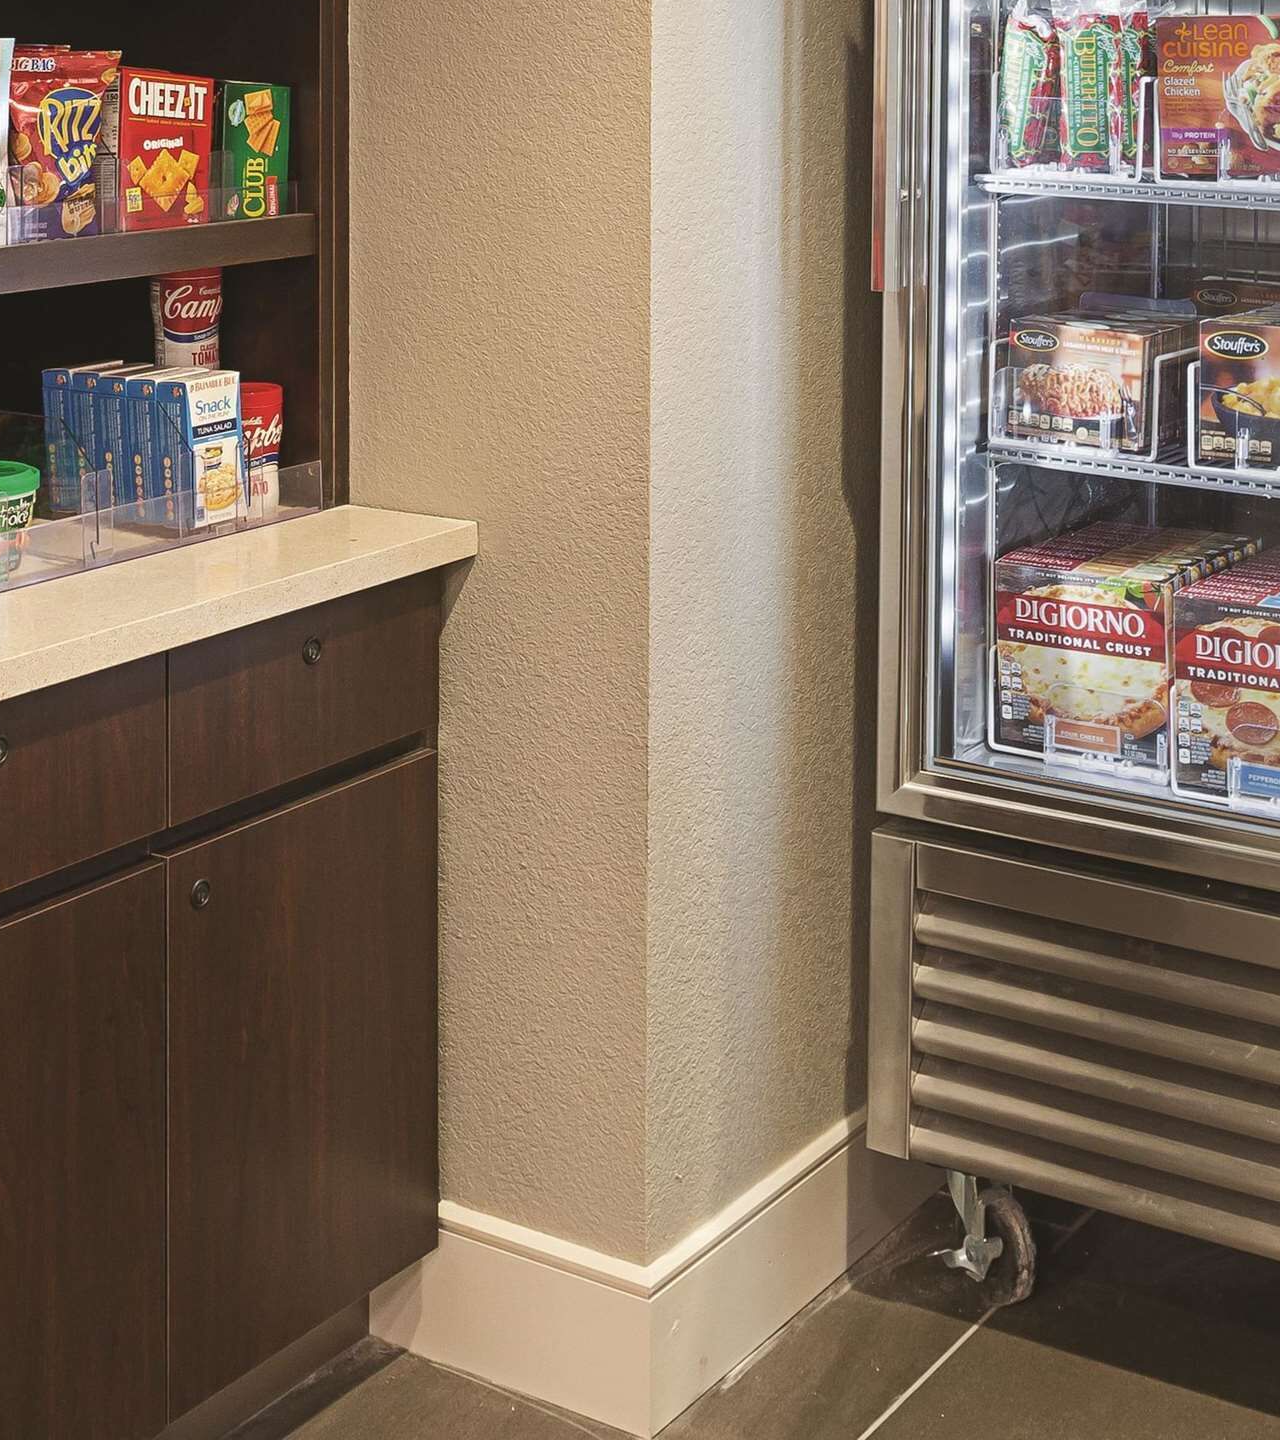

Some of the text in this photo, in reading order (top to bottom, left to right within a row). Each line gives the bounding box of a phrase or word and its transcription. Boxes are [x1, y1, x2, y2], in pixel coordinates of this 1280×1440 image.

[31, 58, 56, 71] BAG
[1163, 76, 1195, 87] Glazed
[1073, 36, 1100, 147] BURRITO
[1164, 86, 1201, 97] Chicken
[40, 98, 102, 158] RITZ
[1183, 131, 1216, 139] PROTEIN
[243, 158, 267, 218] CLUB
[1020, 332, 1056, 348] Stouffer's
[1212, 338, 1261, 357] Stouffer's
[192, 351, 218, 366] TOMA
[195, 395, 231, 415] Snack
[197, 421, 232, 435] TUNA SALAD
[1015, 598, 1145, 638] DIGIORNO
[1008, 628, 1152, 657] TRADITIONAL CRUST
[1079, 733, 1105, 743] CHEESE
